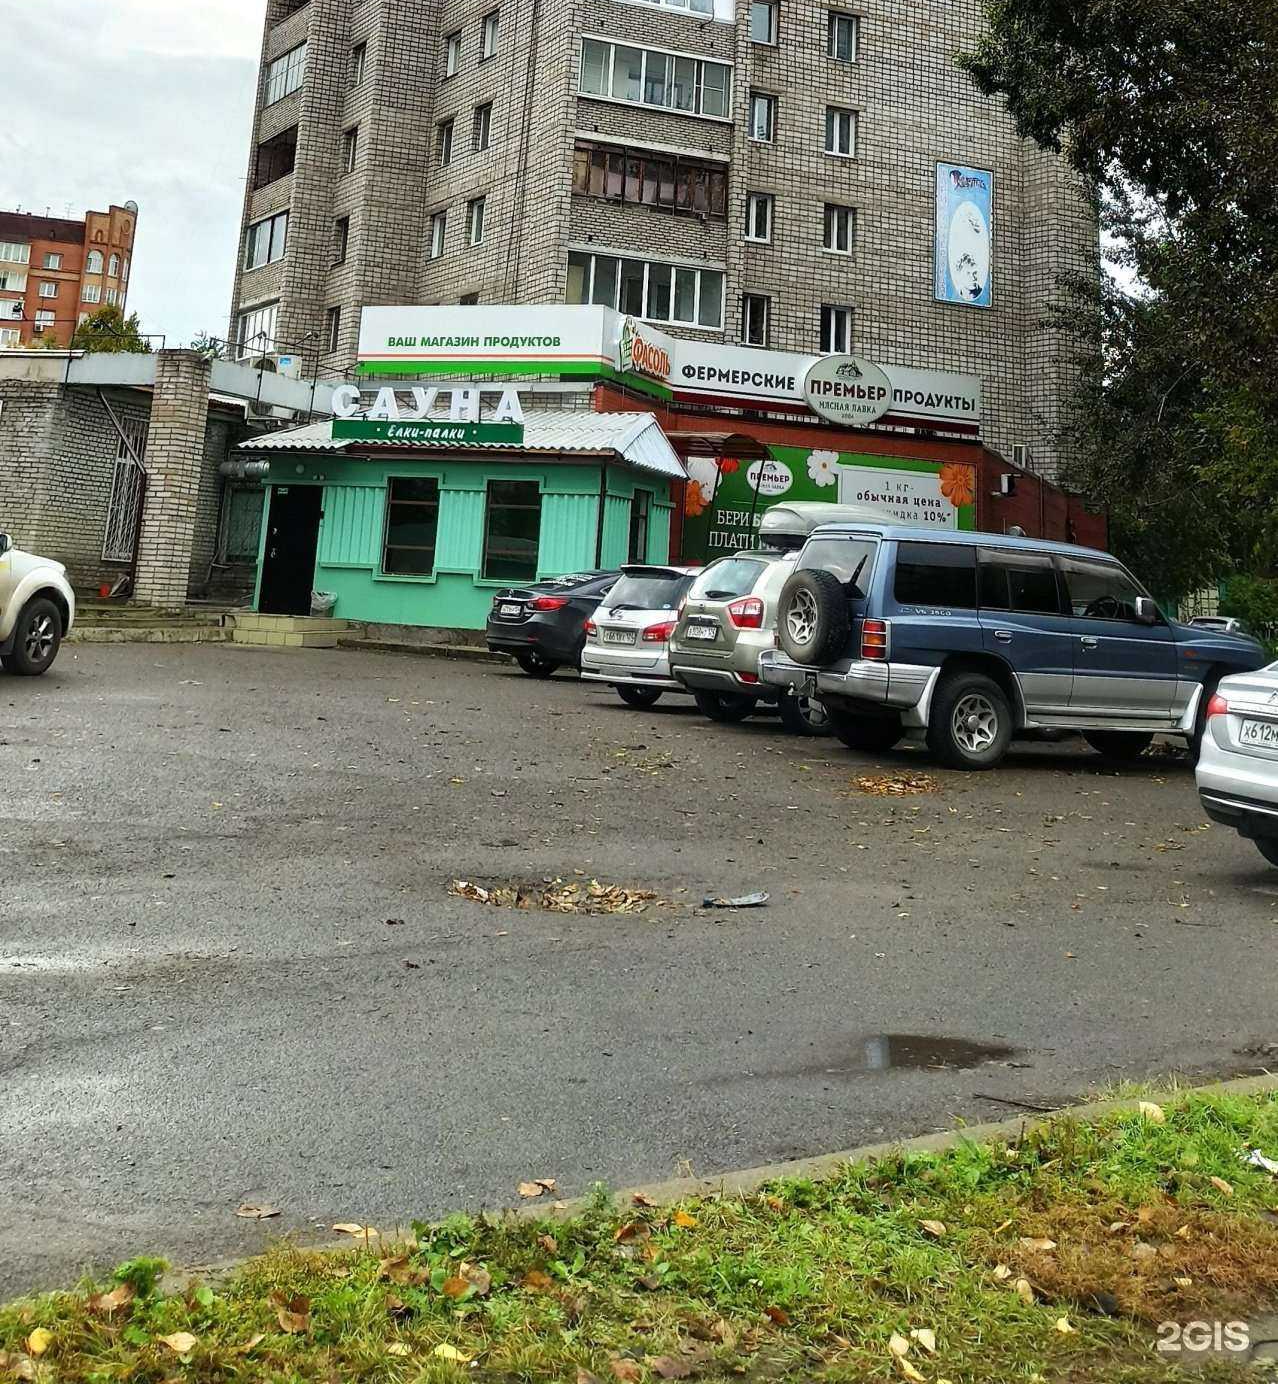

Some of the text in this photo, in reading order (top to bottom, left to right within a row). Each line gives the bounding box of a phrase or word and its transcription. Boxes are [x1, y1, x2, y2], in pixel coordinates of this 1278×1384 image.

[388, 336, 561, 348] ВАШ МАГАЗИН ПРОДУКТОВ
[632, 336, 671, 376] ФАСОЛЬ
[681, 364, 975, 411] ФЕРМЕРСКИЕ ПРОДУКТЫ
[810, 379, 887, 401] ПРЕМЬЕР
[331, 384, 525, 423] САУНА
[819, 400, 877, 414] МЯСНАЯ ЛАВКА
[856, 490, 941, 508] обычная цена
[717, 510, 750, 527] БЕРИ
[885, 509, 918, 520] идка
